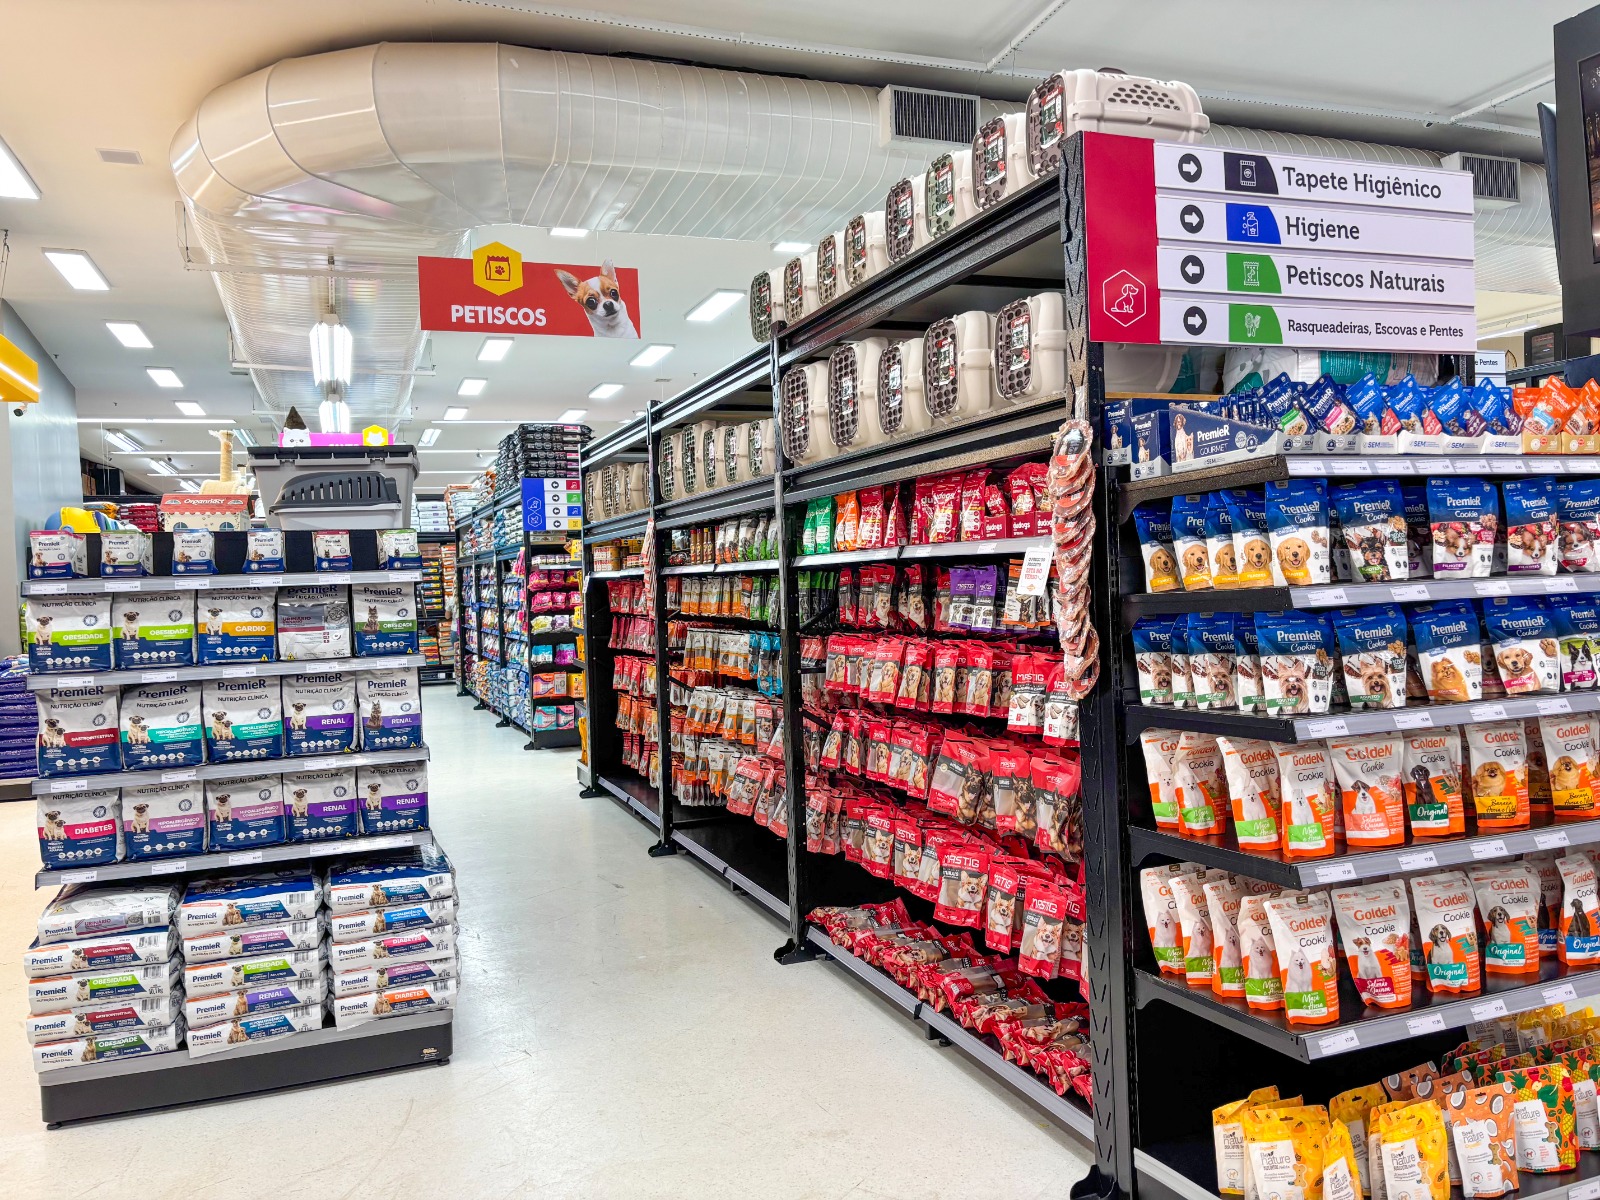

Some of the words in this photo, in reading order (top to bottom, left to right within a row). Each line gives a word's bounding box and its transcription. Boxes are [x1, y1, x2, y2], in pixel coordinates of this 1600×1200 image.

[1283, 166, 1349, 196] Tapete
[1354, 173, 1442, 200] Higiênico
[1285, 216, 1360, 243] Higiene
[1286, 265, 1364, 290] Petiscos
[1370, 270, 1445, 294] Naturais
[451, 304, 547, 327] PETISCOS
[1287, 320, 1371, 339] Rasqueadeiras,
[1375, 323, 1418, 337] Escovas
[1420, 327, 1427, 337] e
[1429, 325, 1464, 339] Pentes
[1480, 358, 1499, 366] Pentes
[1200, 443, 1228, 456] GOURMET
[1294, 514, 1316, 524] Cookie
[1454, 510, 1478, 518] Cookie
[1569, 510, 1594, 519] Cookie
[62, 633, 105, 641] OBESIDADE
[149, 628, 189, 636] OBESIDADE
[1516, 627, 1540, 638] Cookie
[1367, 639, 1387, 650] Cookie
[1442, 634, 1462, 645] Cookie
[1290, 642, 1316, 652] Cookie
[321, 717, 346, 725] RENAL
[391, 717, 412, 725] RENAL
[1564, 740, 1590, 751] Cookie
[1494, 748, 1521, 758] Cookie
[1188, 759, 1214, 770] Cookie
[1420, 753, 1446, 765] Cookie
[1249, 766, 1275, 778] Cookie
[1360, 760, 1385, 774] Cookie
[1297, 771, 1324, 782] Cookie
[396, 797, 419, 805] RENAL
[322, 804, 347, 813] RENAL
[1417, 805, 1448, 821] Original
[74, 823, 114, 836] DIABETES
[944, 854, 980, 869] MASTIG
[1501, 894, 1529, 905] Cookie
[1443, 910, 1470, 922] Cookie
[1364, 924, 1396, 936] Cookie
[1490, 945, 1523, 961] Original
[246, 960, 284, 970] OBESIDADE
[1433, 965, 1465, 980] Original
[92, 975, 133, 985] OBESIDADE
[258, 991, 283, 1000] RENAL
[394, 990, 424, 1000] DIABETES
[98, 1037, 138, 1048] OBESIDADE
[1574, 1089, 1594, 1100] nature
[1516, 1109, 1541, 1119] nature
[1462, 1132, 1485, 1144] nature
[1260, 1154, 1291, 1166] nature
[1391, 1153, 1416, 1167] nature
